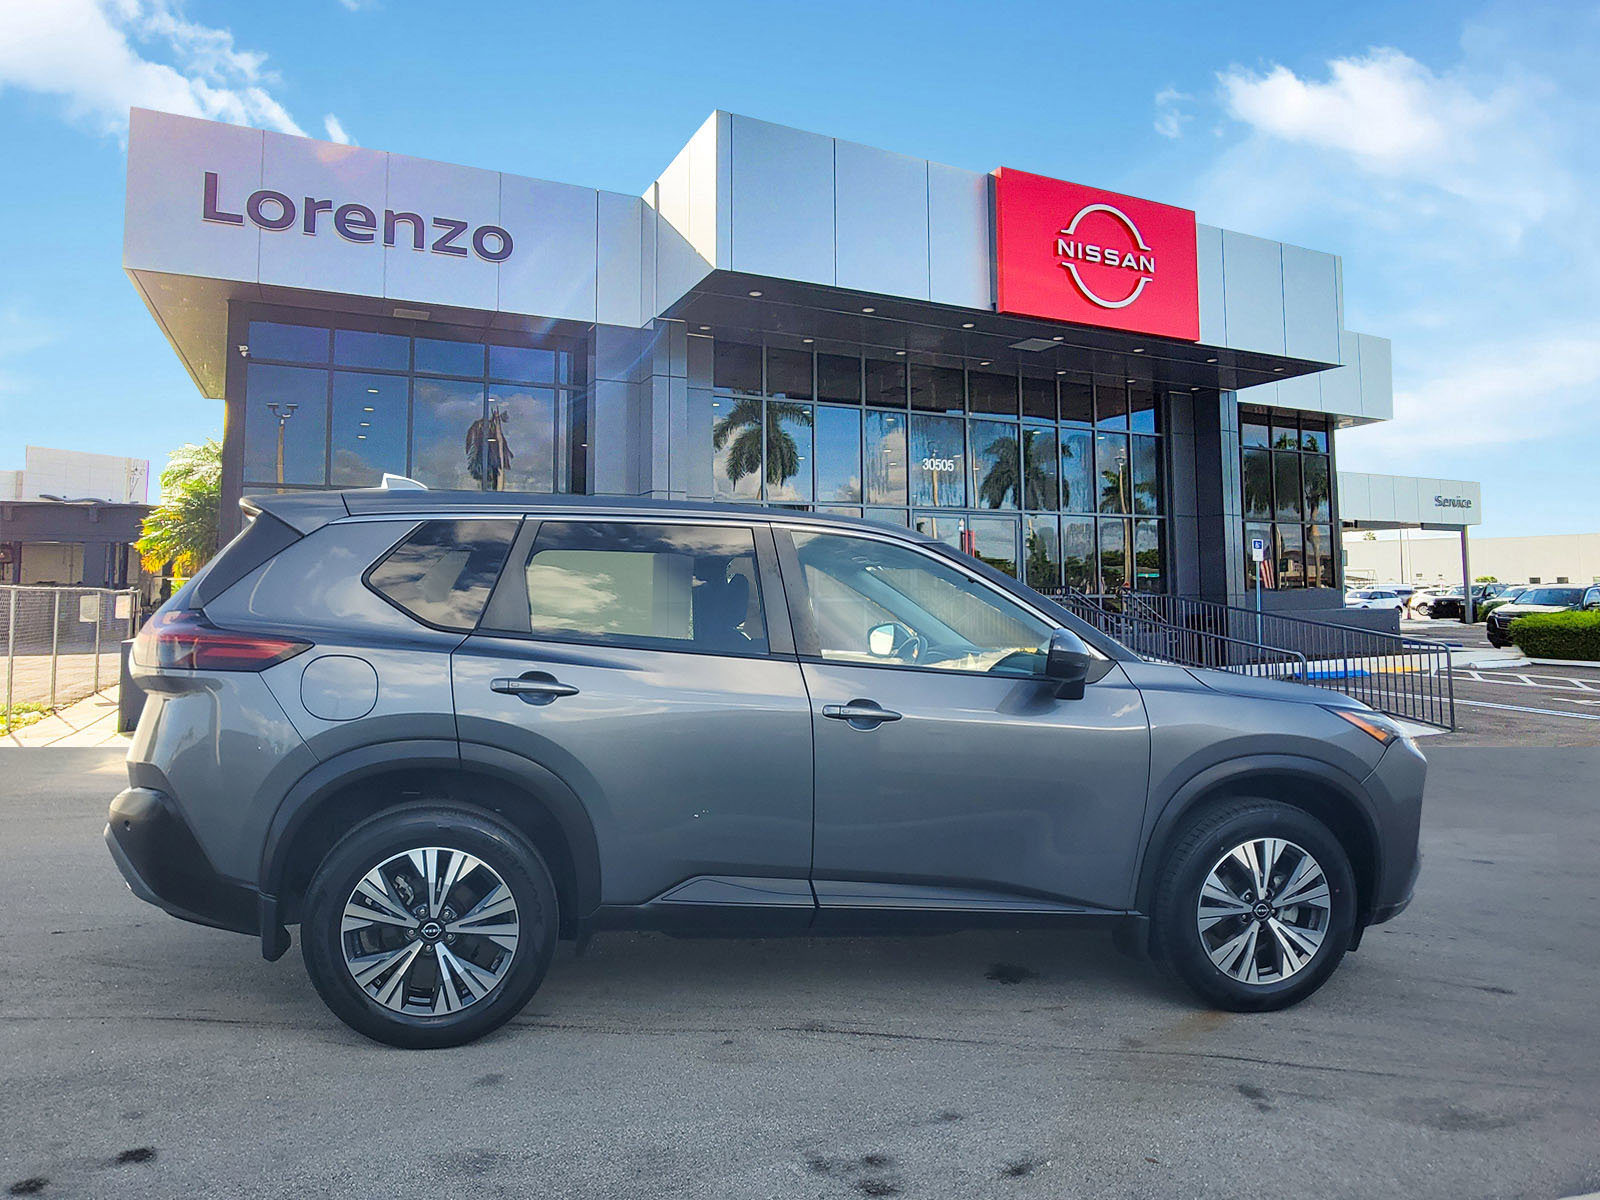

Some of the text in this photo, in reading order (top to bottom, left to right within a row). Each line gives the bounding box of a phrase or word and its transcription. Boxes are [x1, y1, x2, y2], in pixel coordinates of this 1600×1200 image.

[203, 171, 514, 262] Lorenzo
[1057, 238, 1155, 273] NISSAN
[922, 458, 954, 471] 30505
[1434, 495, 1472, 509] Service
